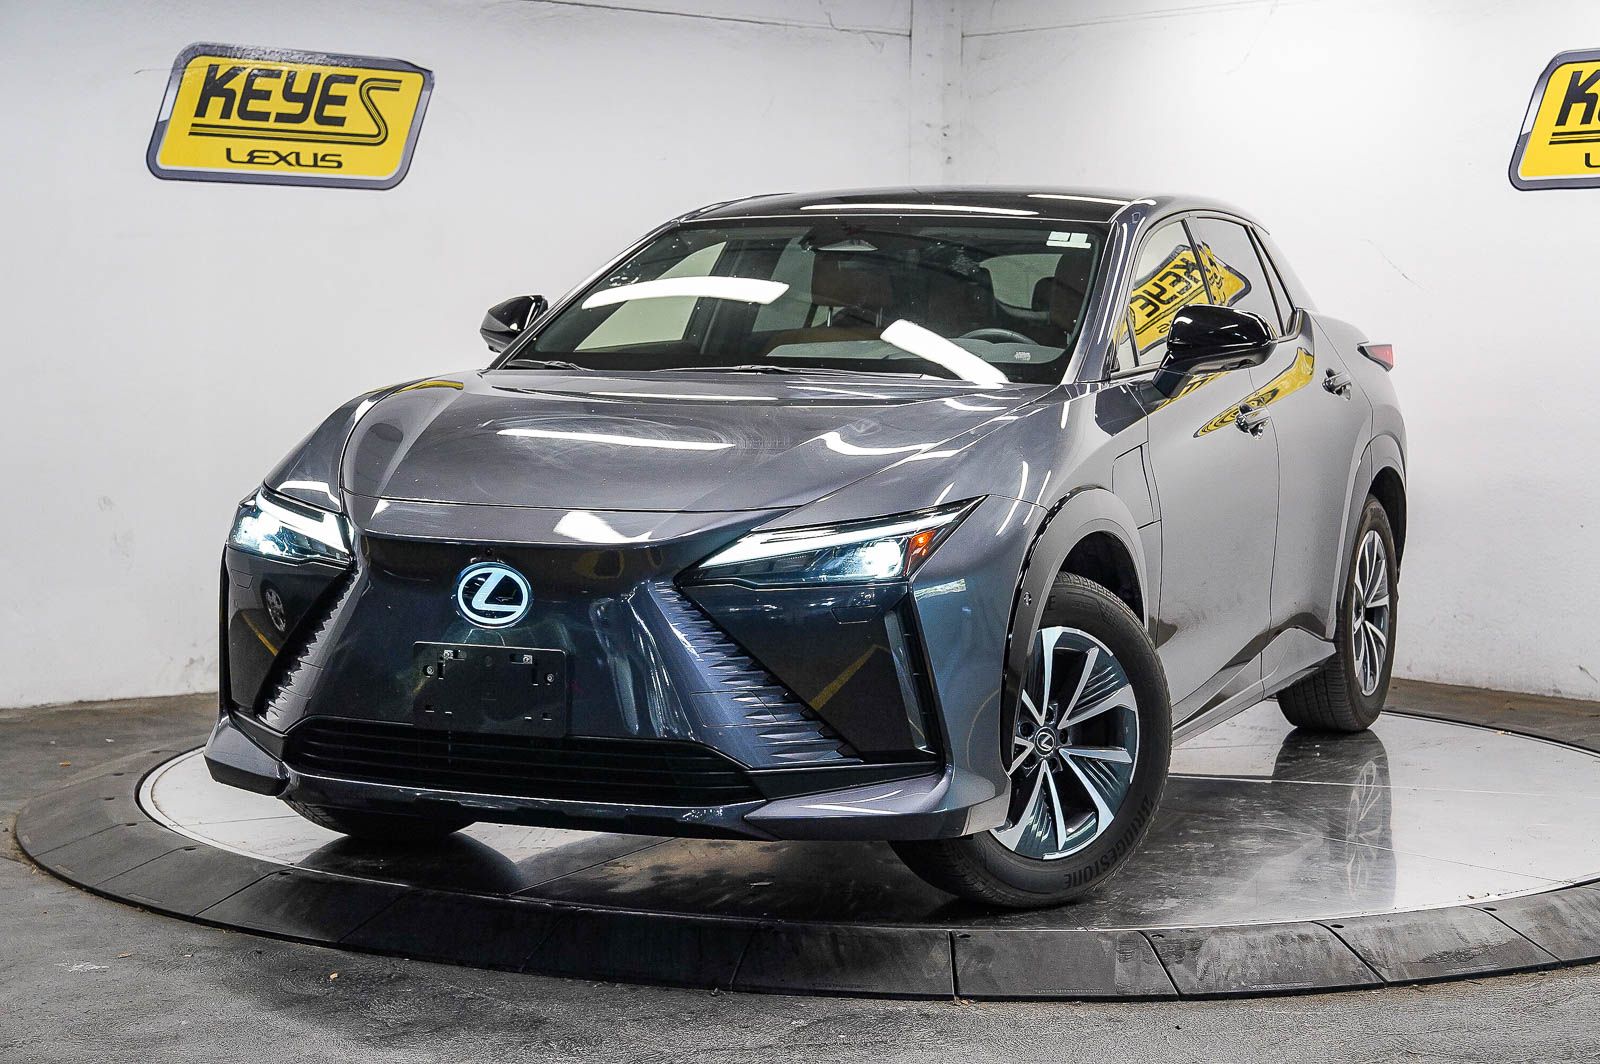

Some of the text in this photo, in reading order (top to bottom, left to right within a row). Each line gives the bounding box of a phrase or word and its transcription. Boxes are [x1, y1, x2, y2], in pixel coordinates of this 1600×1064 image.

[193, 63, 403, 146] KEYES
[225, 147, 343, 169] LEXUS
[1062, 794, 1156, 890] BRIDGESTONE
